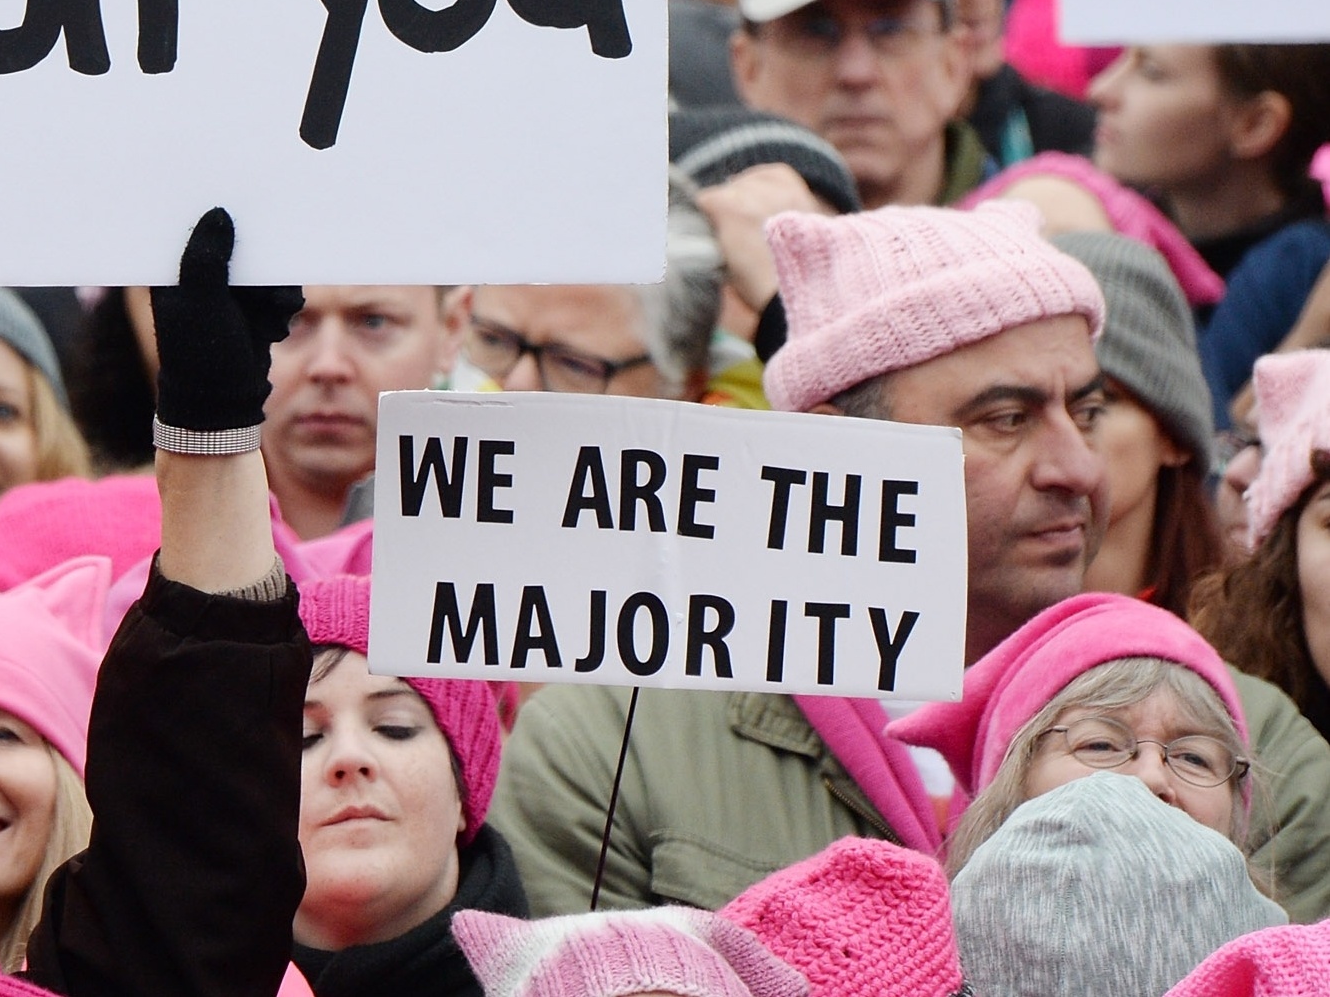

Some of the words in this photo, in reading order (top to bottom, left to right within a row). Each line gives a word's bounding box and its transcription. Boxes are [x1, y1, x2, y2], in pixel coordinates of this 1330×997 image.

[398, 434, 515, 525] WE
[561, 445, 720, 540] ARE
[760, 465, 919, 564] THE
[426, 581, 920, 692] MAJORITY
